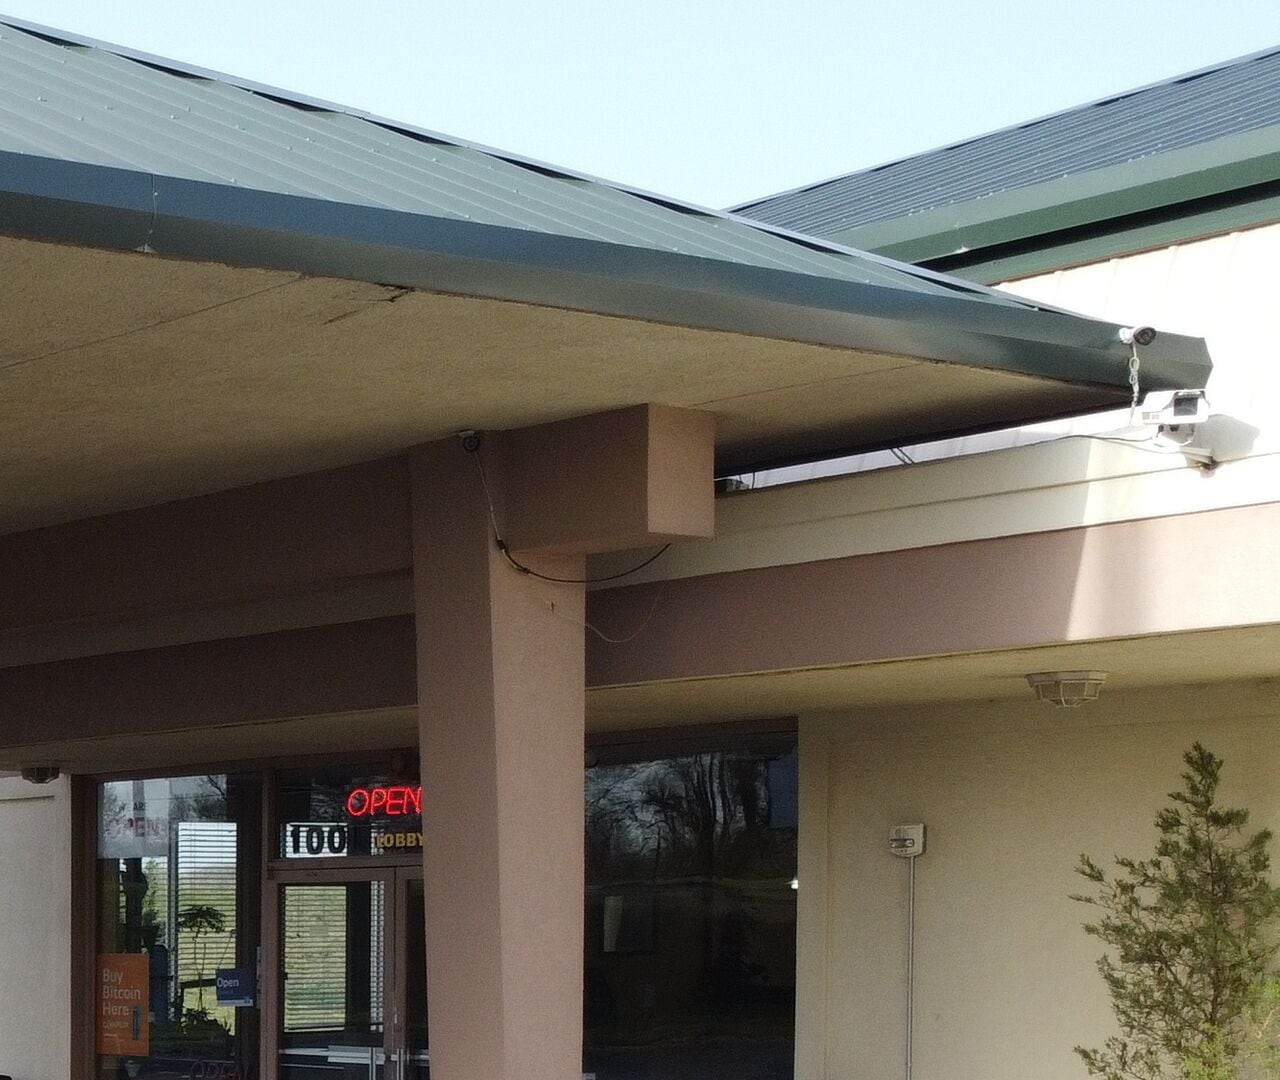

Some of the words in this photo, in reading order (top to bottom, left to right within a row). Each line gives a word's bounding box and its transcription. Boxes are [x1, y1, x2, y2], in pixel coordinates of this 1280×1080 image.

[347, 786, 422, 816] OPEN
[376, 832, 423, 848] LOBBY
[102, 968, 124, 985] Buy
[216, 977, 240, 989] Open
[102, 985, 141, 1000] Bitcoin
[102, 1001, 130, 1016] Here
